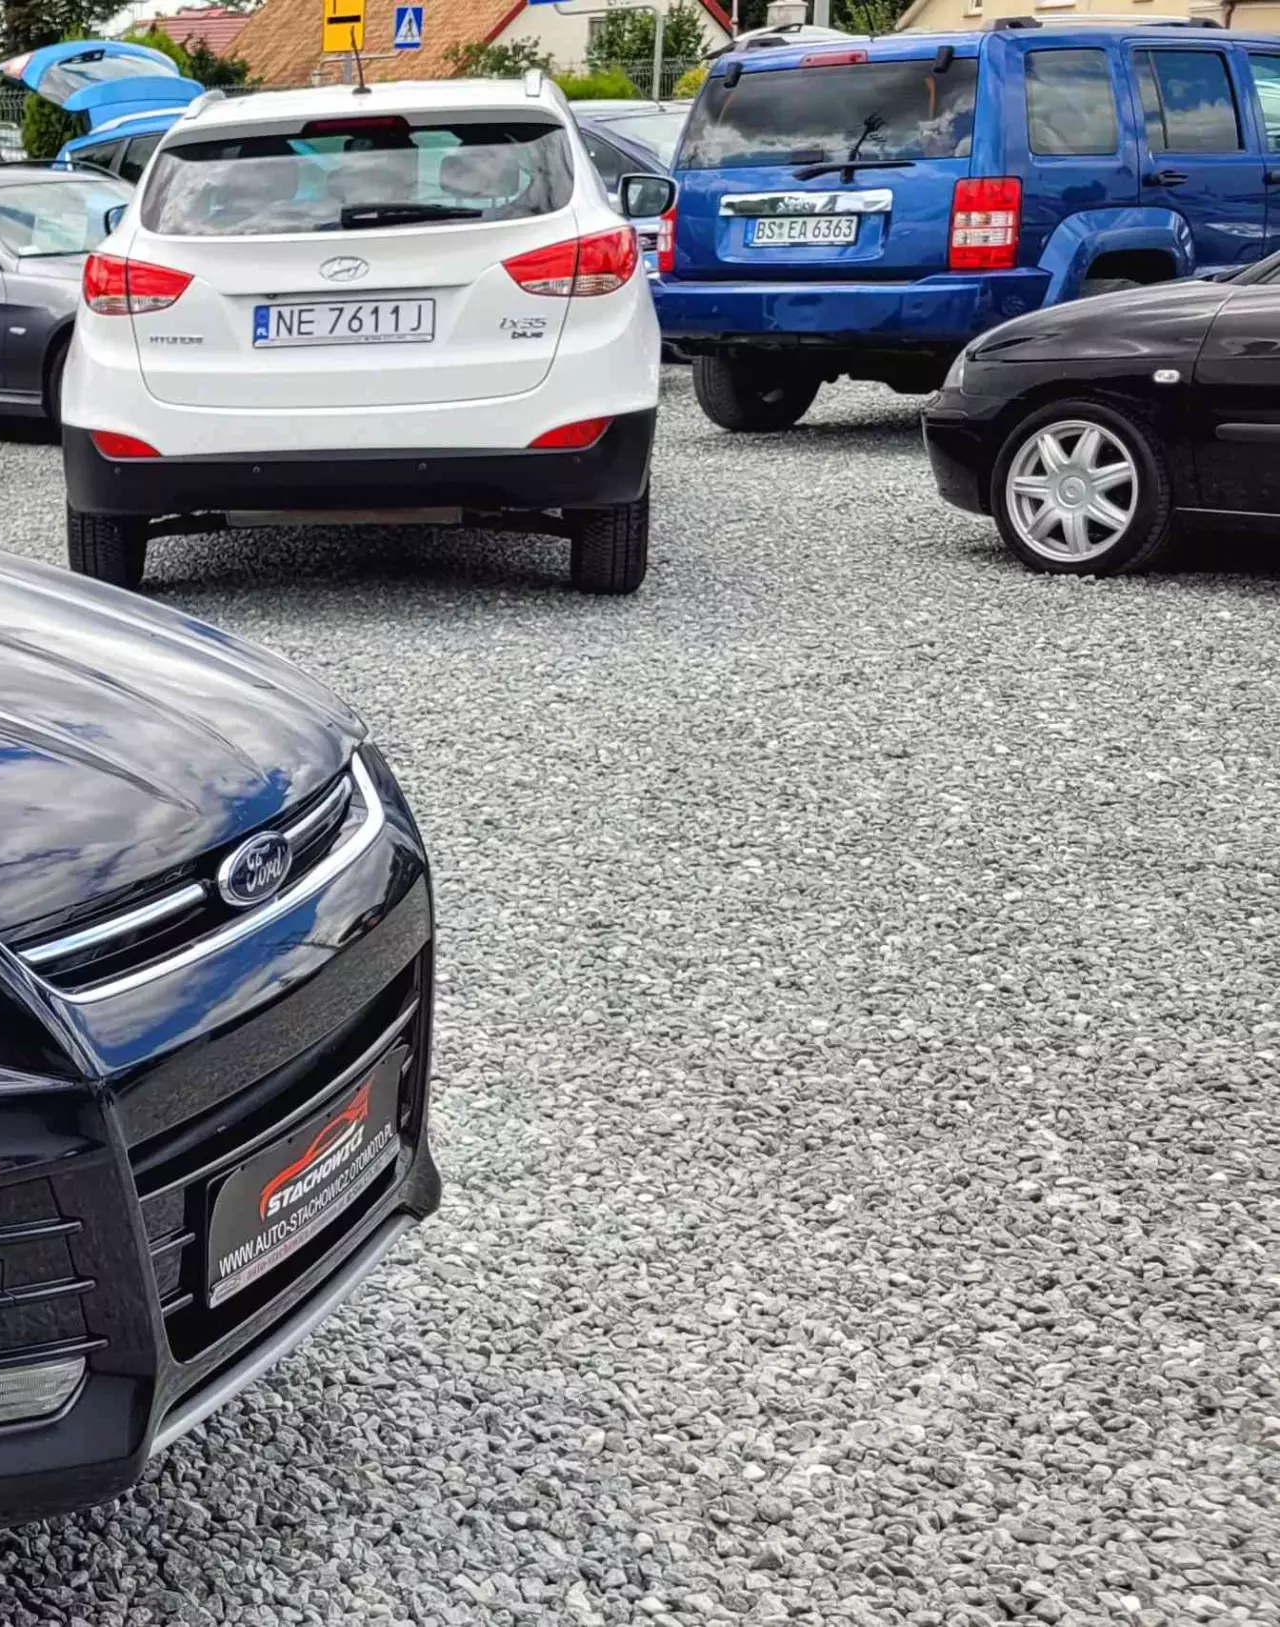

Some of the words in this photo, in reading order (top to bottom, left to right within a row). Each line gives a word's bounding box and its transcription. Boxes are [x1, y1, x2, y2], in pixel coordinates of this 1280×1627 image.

[756, 220, 777, 239] BS
[787, 219, 808, 239] EA
[812, 218, 854, 238] 6363
[276, 307, 315, 337] NE
[328, 304, 423, 335] 7611J
[246, 842, 285, 892] Ford
